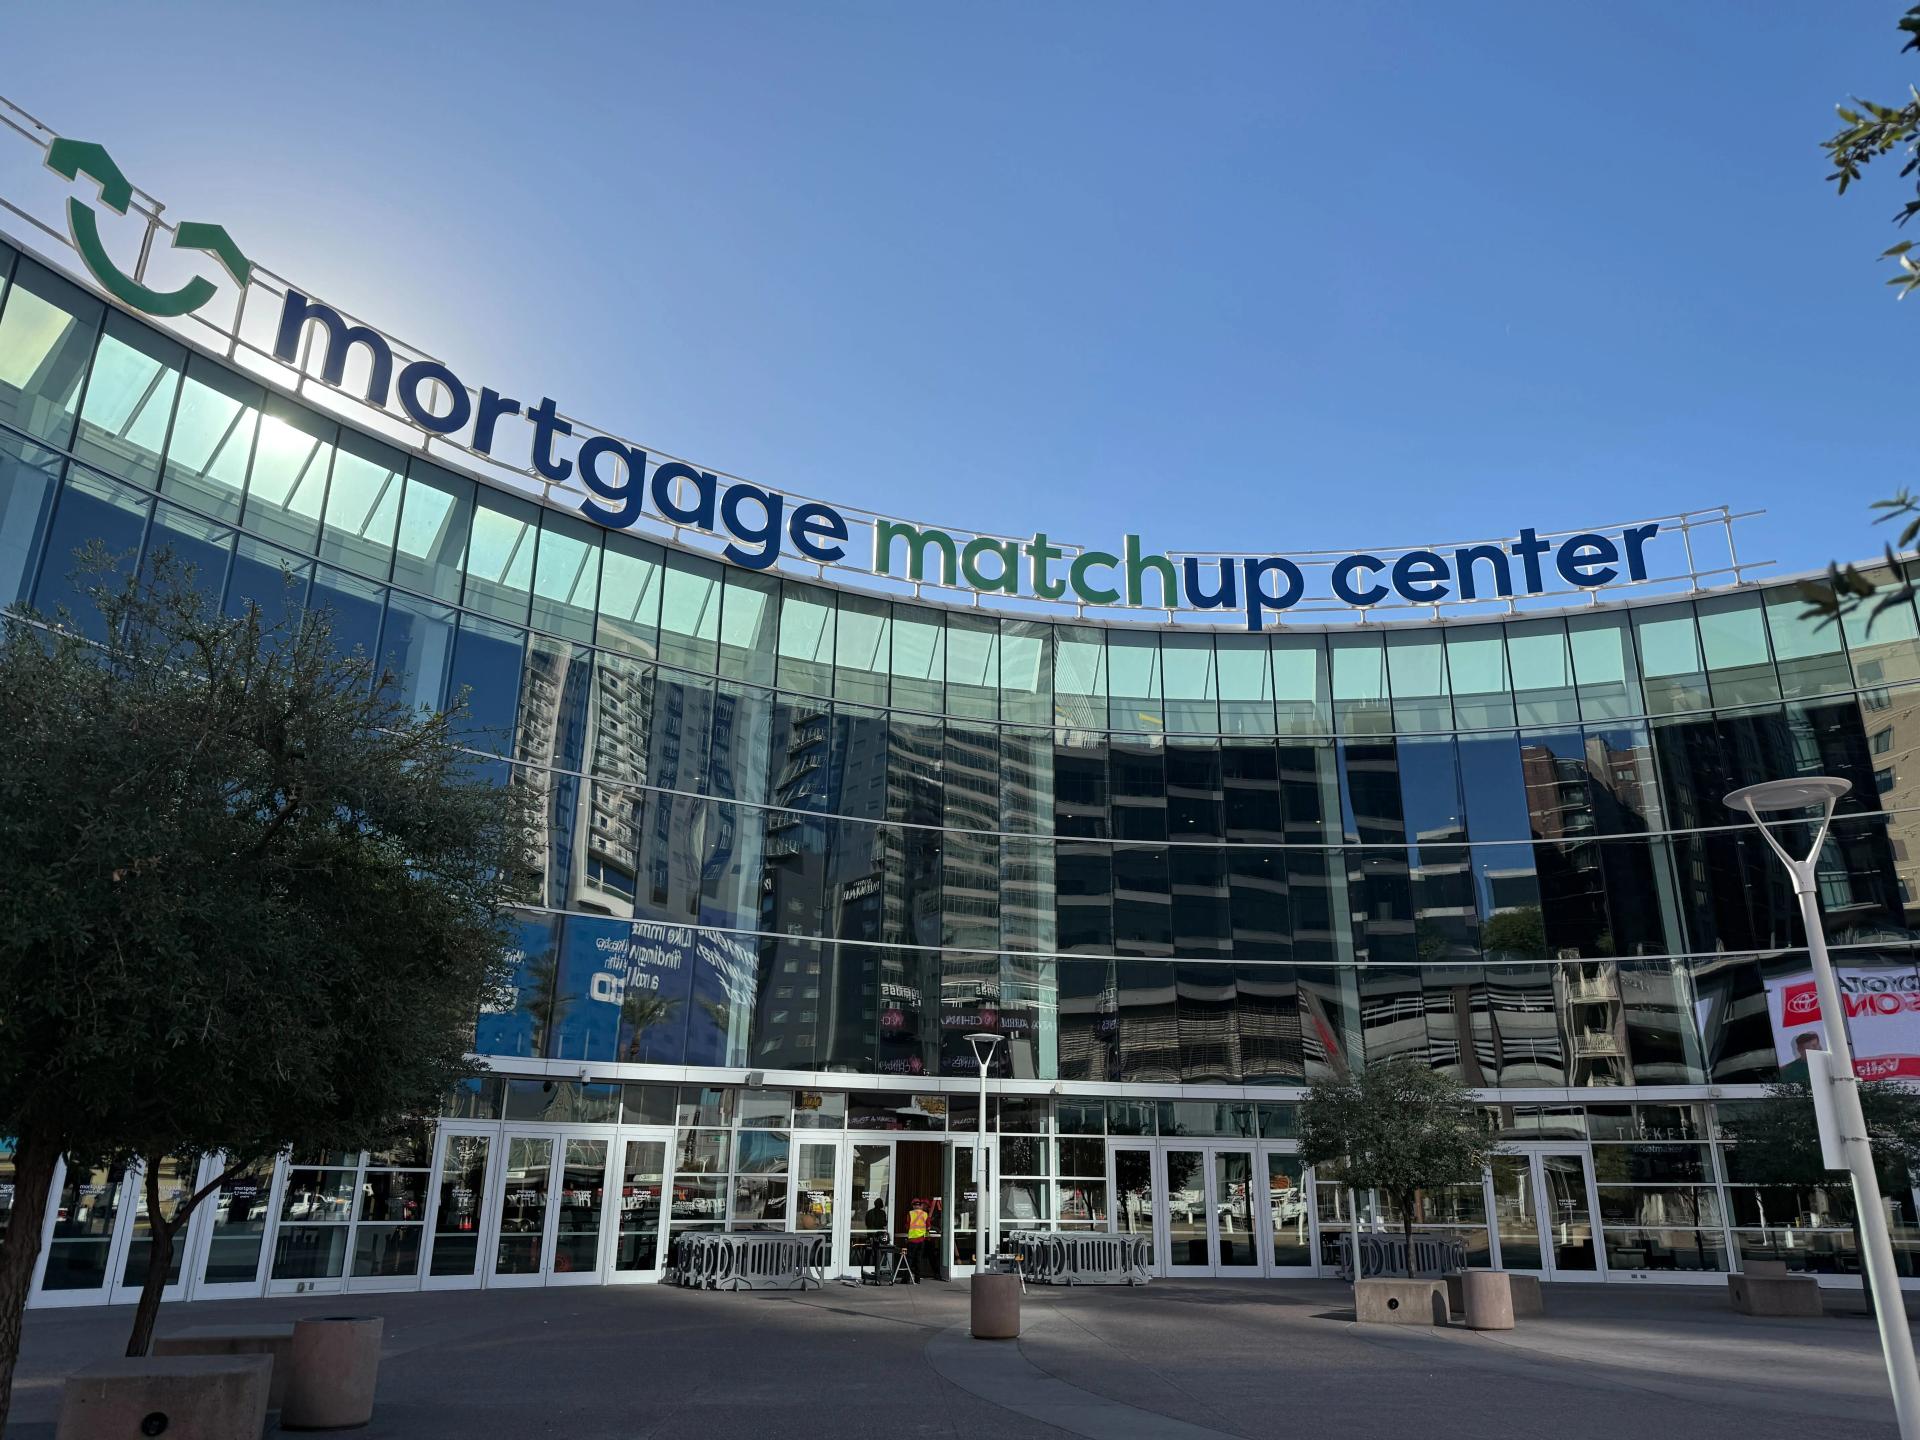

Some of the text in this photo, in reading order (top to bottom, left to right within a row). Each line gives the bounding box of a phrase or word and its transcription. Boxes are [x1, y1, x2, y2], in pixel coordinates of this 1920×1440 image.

[272, 287, 1660, 631] mortgage matchup center
